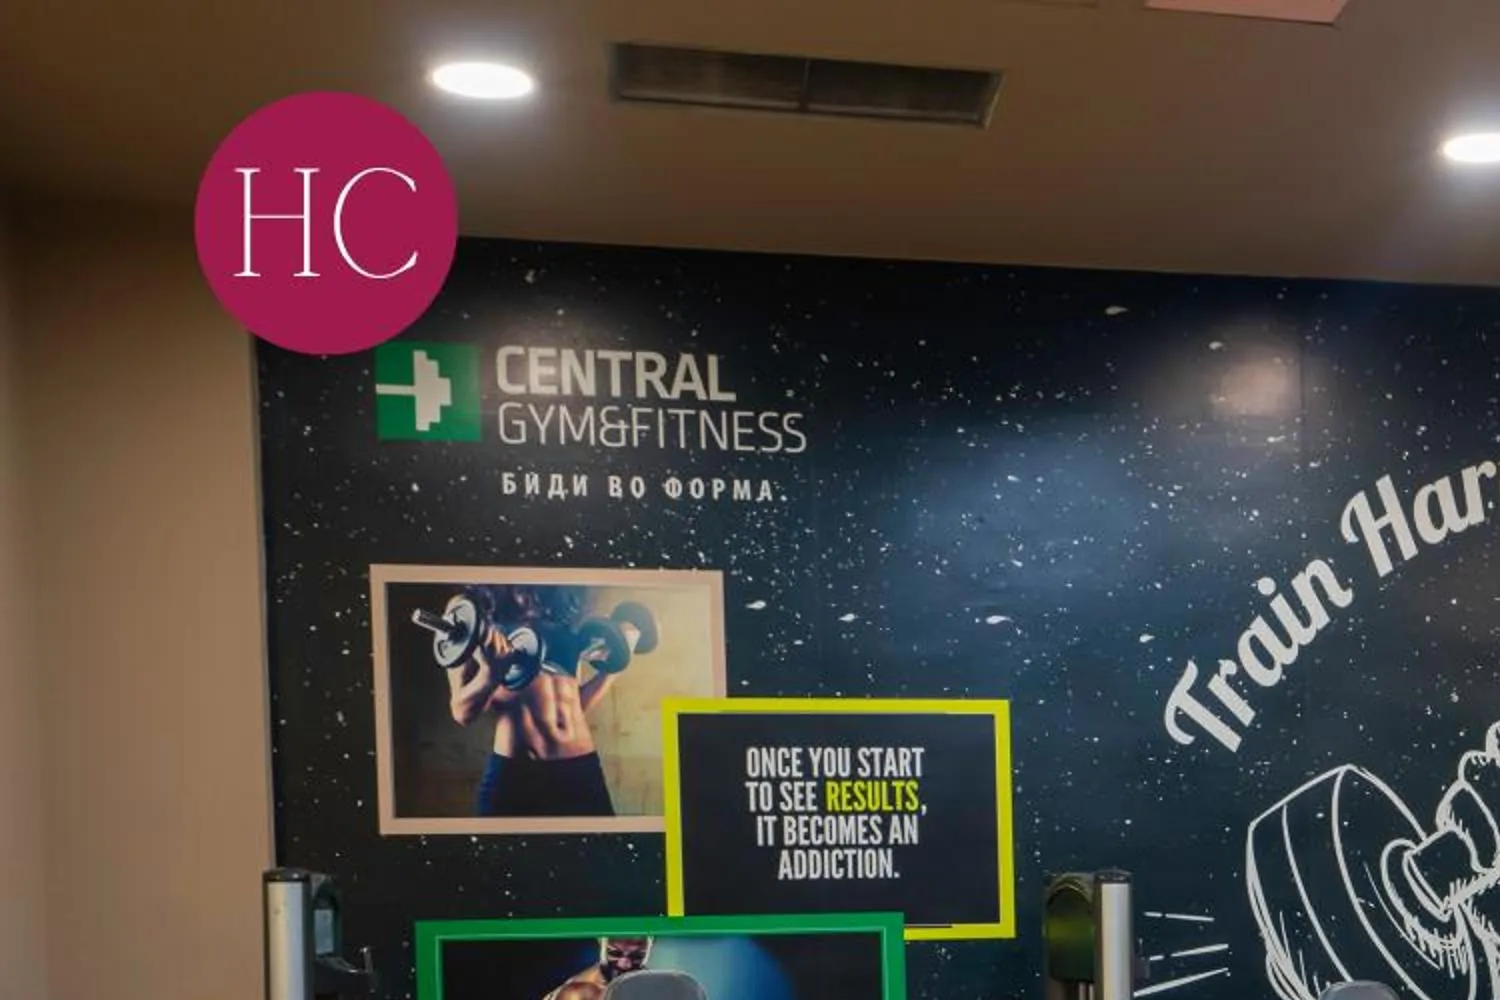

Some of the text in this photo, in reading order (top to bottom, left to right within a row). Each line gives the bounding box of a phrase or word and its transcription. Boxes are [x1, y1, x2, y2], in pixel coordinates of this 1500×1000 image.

[495, 346, 736, 402] CENTRAL
[499, 402, 807, 453] GYM&FITNESS
[502, 472, 588, 501] БИДИ
[608, 475, 646, 499] ВО
[1164, 558, 1354, 754] Train
[746, 747, 924, 777] ONCE YOU START
[745, 780, 927, 815] TO SEE RESULTS,
[756, 814, 919, 846] IT BECOMES AN
[777, 848, 900, 880] ADDICTION.
